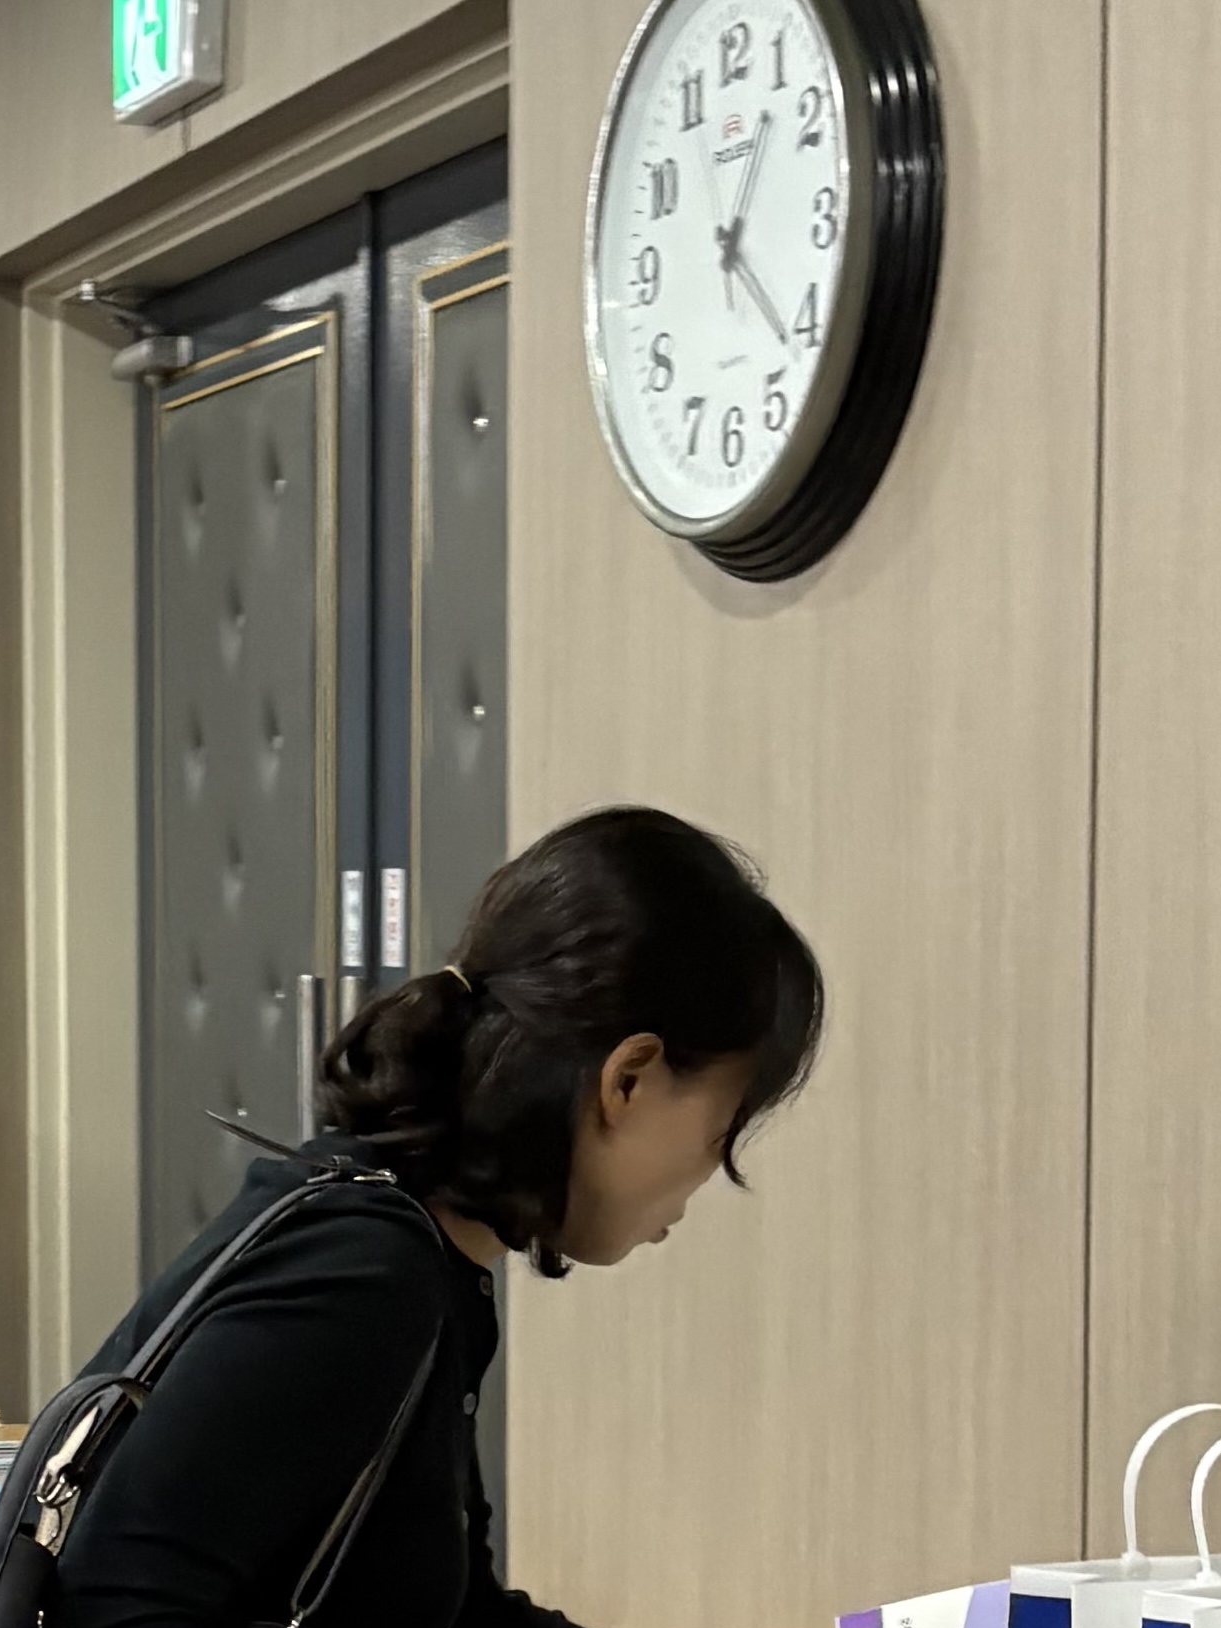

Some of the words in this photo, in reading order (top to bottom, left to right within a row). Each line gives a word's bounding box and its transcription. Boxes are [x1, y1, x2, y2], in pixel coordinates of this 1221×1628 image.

[718, 22, 751, 88] 12
[769, 29, 787, 90] 1
[682, 70, 703, 131] 11
[797, 86, 822, 151] 2
[812, 187, 837, 250] 3
[638, 246, 661, 305] 9
[794, 282, 821, 348] 4
[649, 333, 674, 392] 8
[683, 396, 705, 456] 7
[764, 368, 787, 431] 5
[721, 406, 744, 468] 6
